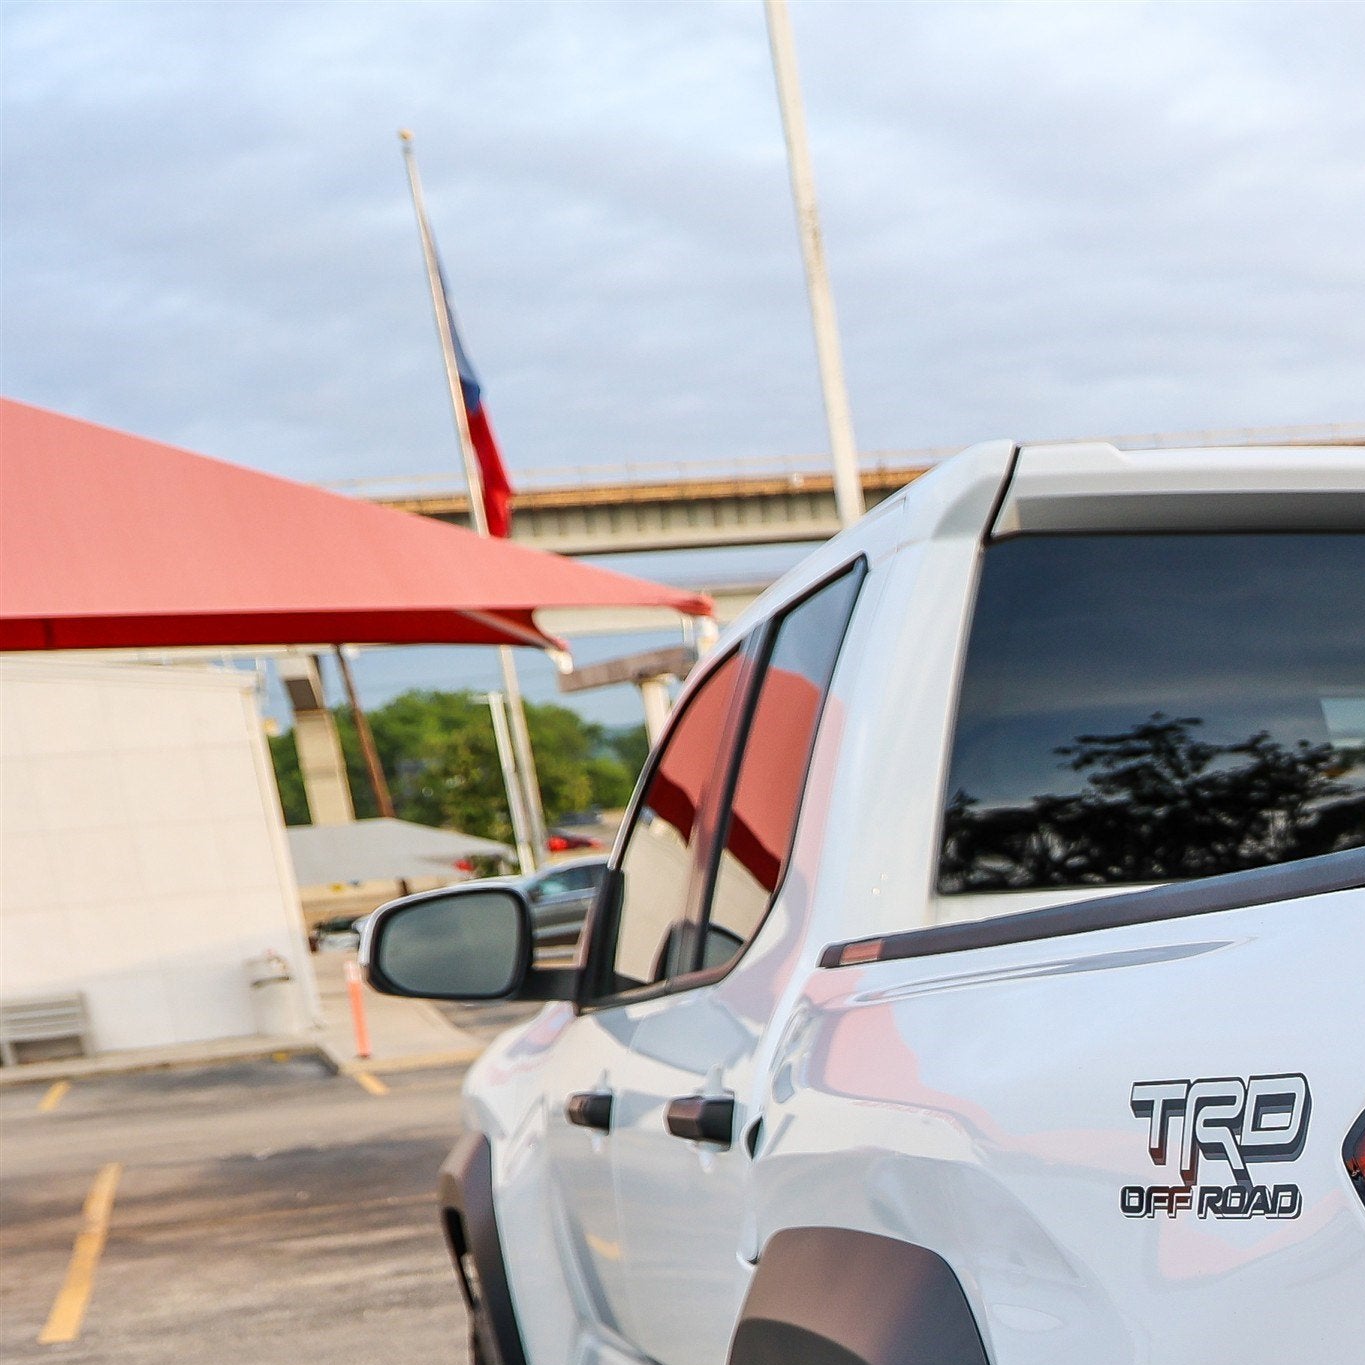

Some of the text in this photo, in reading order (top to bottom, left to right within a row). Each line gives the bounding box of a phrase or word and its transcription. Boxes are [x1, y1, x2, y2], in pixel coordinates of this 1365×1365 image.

[1129, 1072, 1312, 1187] TRD
[1120, 1183, 1303, 1220] OFF ROAD
